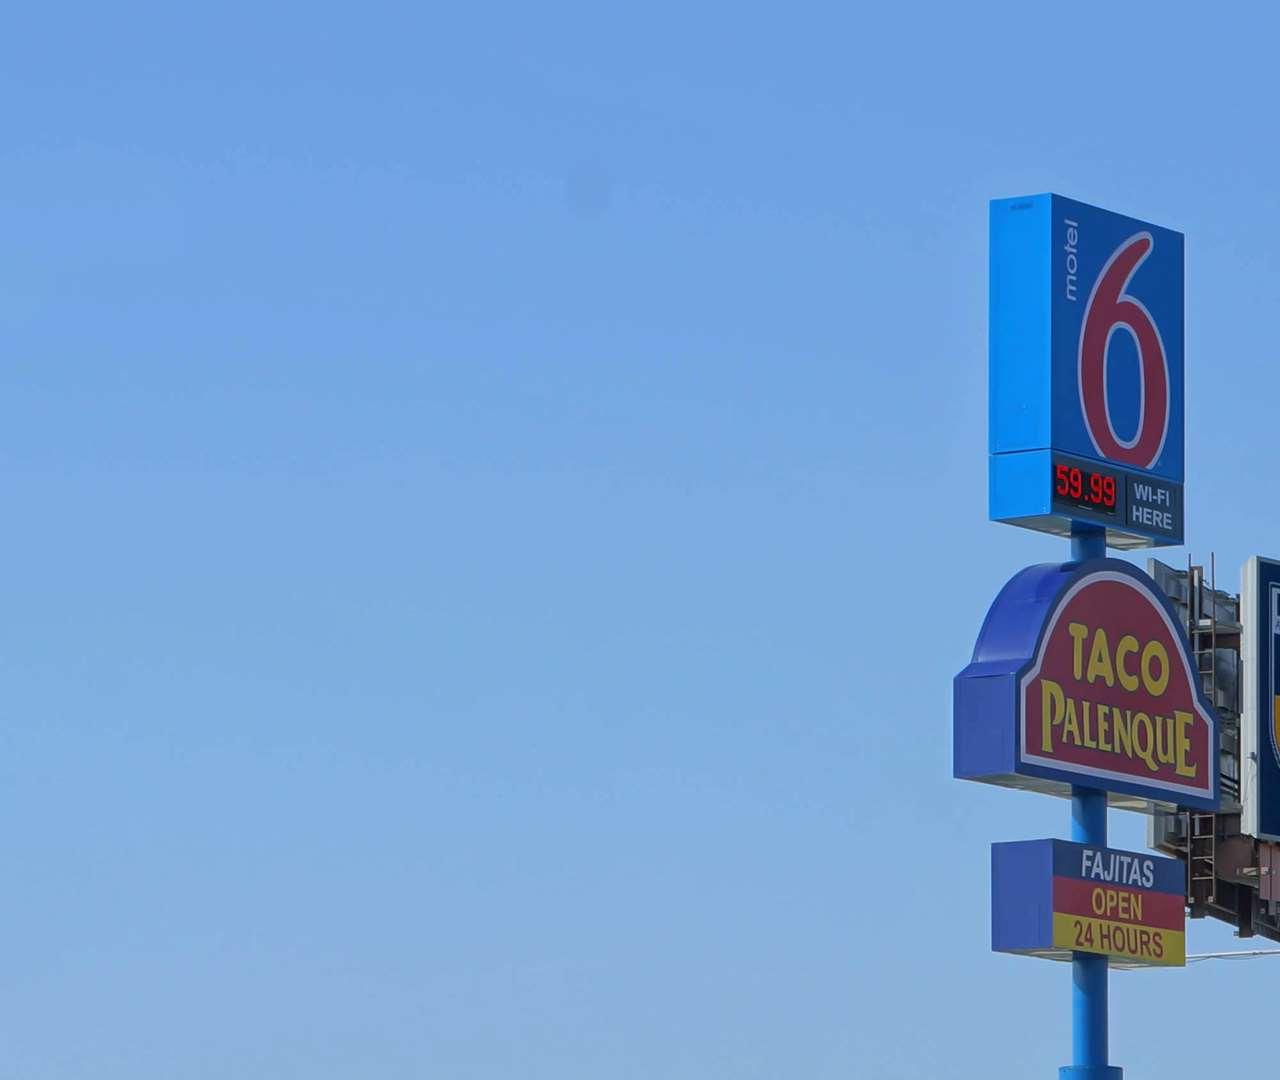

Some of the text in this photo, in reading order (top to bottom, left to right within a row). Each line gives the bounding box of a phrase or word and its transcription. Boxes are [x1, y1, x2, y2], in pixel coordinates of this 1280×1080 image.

[1064, 218, 1170, 469] motel 6
[1056, 464, 1117, 507] 59.99
[1133, 482, 1170, 506] WI-FI
[1132, 505, 1172, 530] HERE
[1068, 622, 1170, 697] TACO
[1040, 678, 1197, 777] PALENQUE
[1081, 849, 1154, 888] FAJITAS
[1092, 887, 1142, 921] OPEN
[1074, 920, 1164, 959] 24 HOURS
